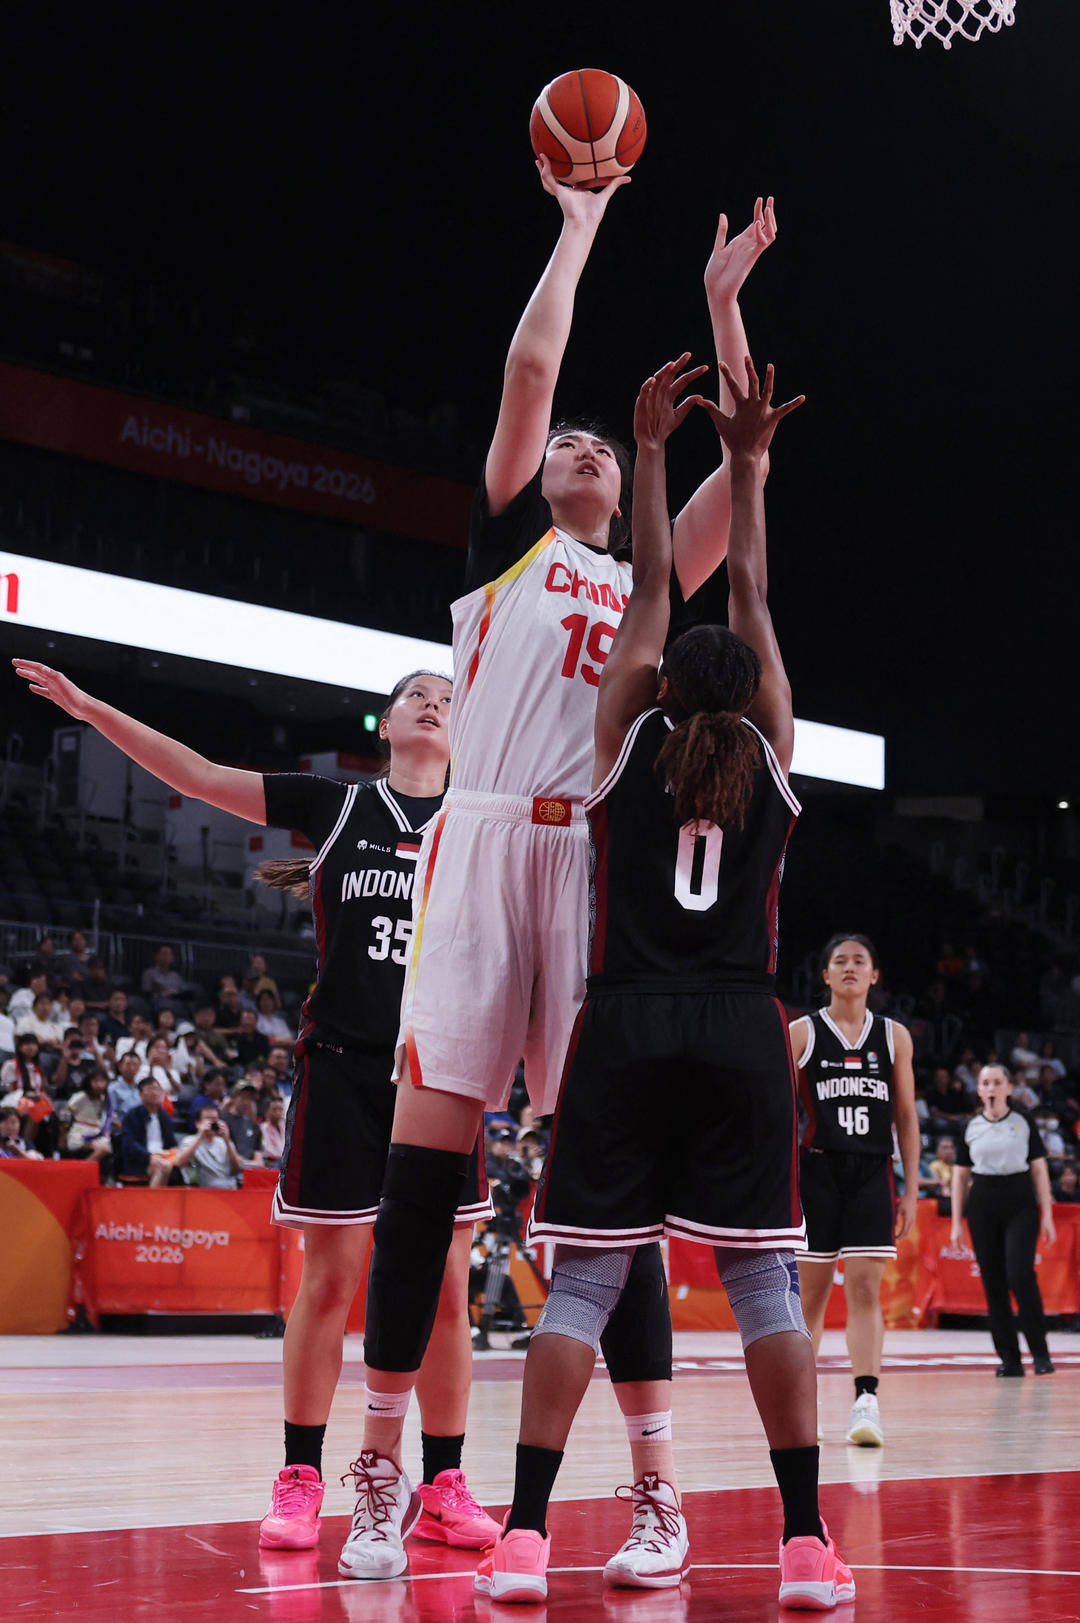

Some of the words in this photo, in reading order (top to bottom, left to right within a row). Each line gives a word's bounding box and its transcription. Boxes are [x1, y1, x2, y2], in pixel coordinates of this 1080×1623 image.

[120, 415, 310, 490] Aichi-Nagoya
[312, 465, 377, 504] 2026
[560, 613, 618, 687] 19
[369, 843, 391, 853] MILLS
[674, 817, 724, 912] 0
[367, 915, 413, 966] 35
[816, 1077, 890, 1102] INDONESIA
[838, 1106, 870, 1136] 46
[95, 1221, 230, 1250] Aichi-Nagoya
[135, 1245, 184, 1264] 2026
